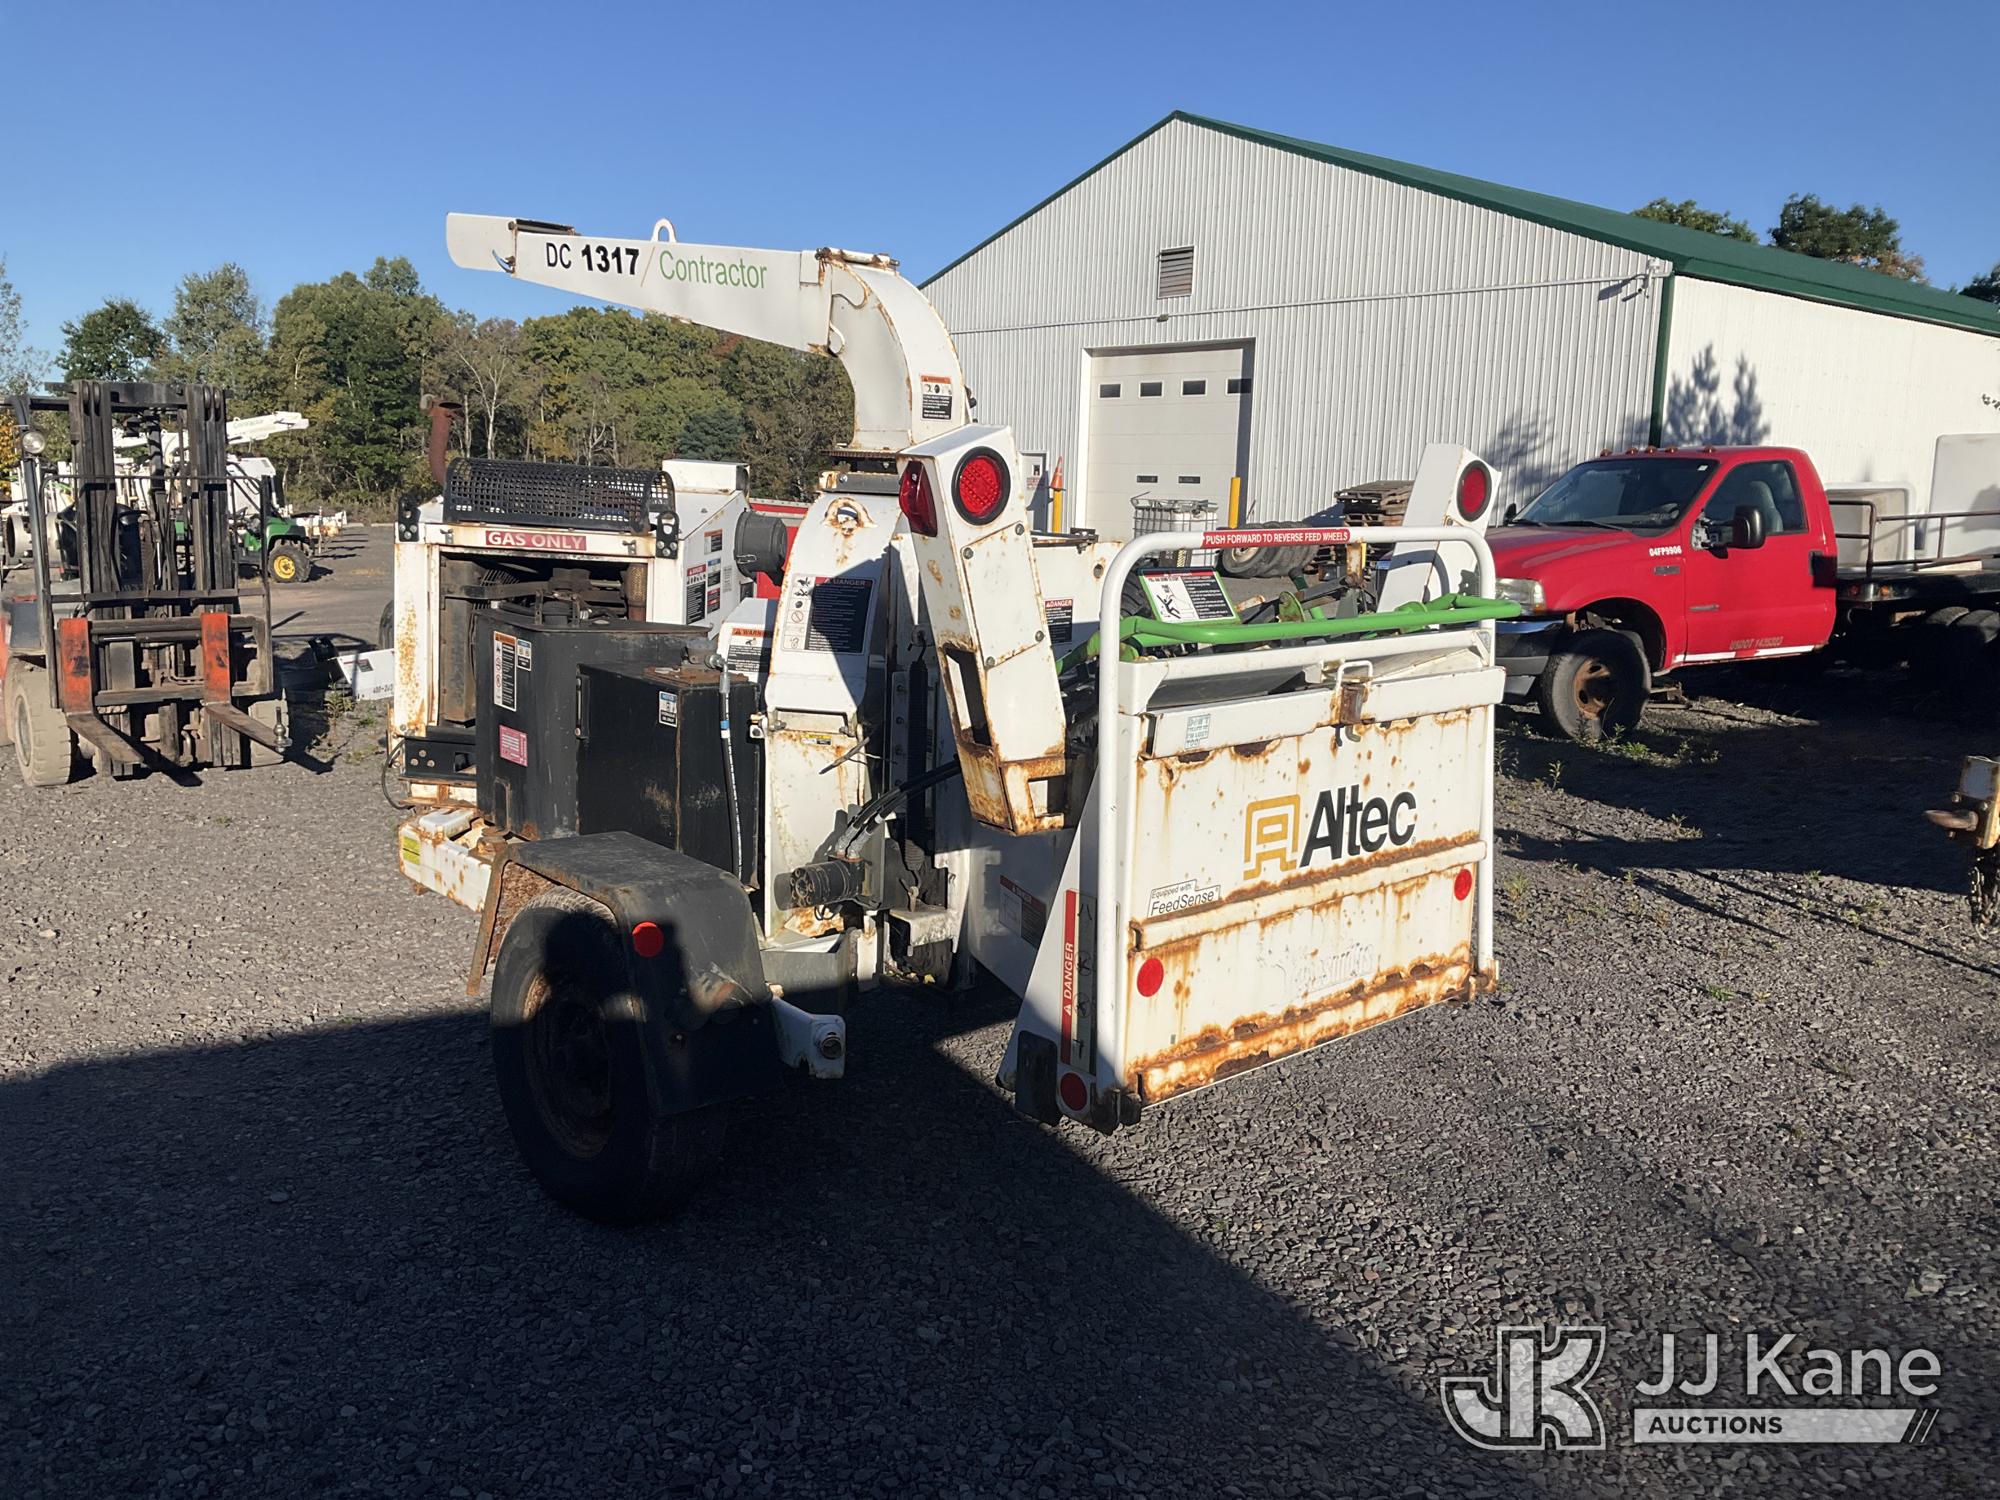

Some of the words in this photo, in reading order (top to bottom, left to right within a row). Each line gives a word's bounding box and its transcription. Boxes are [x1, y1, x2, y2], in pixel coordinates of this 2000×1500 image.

[546, 242, 572, 269] DC
[581, 244, 639, 275] 1317
[659, 250, 767, 289] Contractor
[488, 531, 527, 546] GAS
[531, 534, 583, 549] ONLY
[1206, 535, 1225, 545] PUSH
[1227, 534, 1261, 544] FORWARD
[1262, 533, 1272, 543] TO
[1274, 533, 1303, 542] REVERSE
[1304, 532, 1321, 541] FEED
[1322, 531, 1348, 541] WHEELS
[1299, 784, 1417, 867] Altec
[1151, 886, 1179, 899] Equipped
[1151, 890, 1214, 916] FeedSense
[1064, 942, 1074, 999] DANGER
